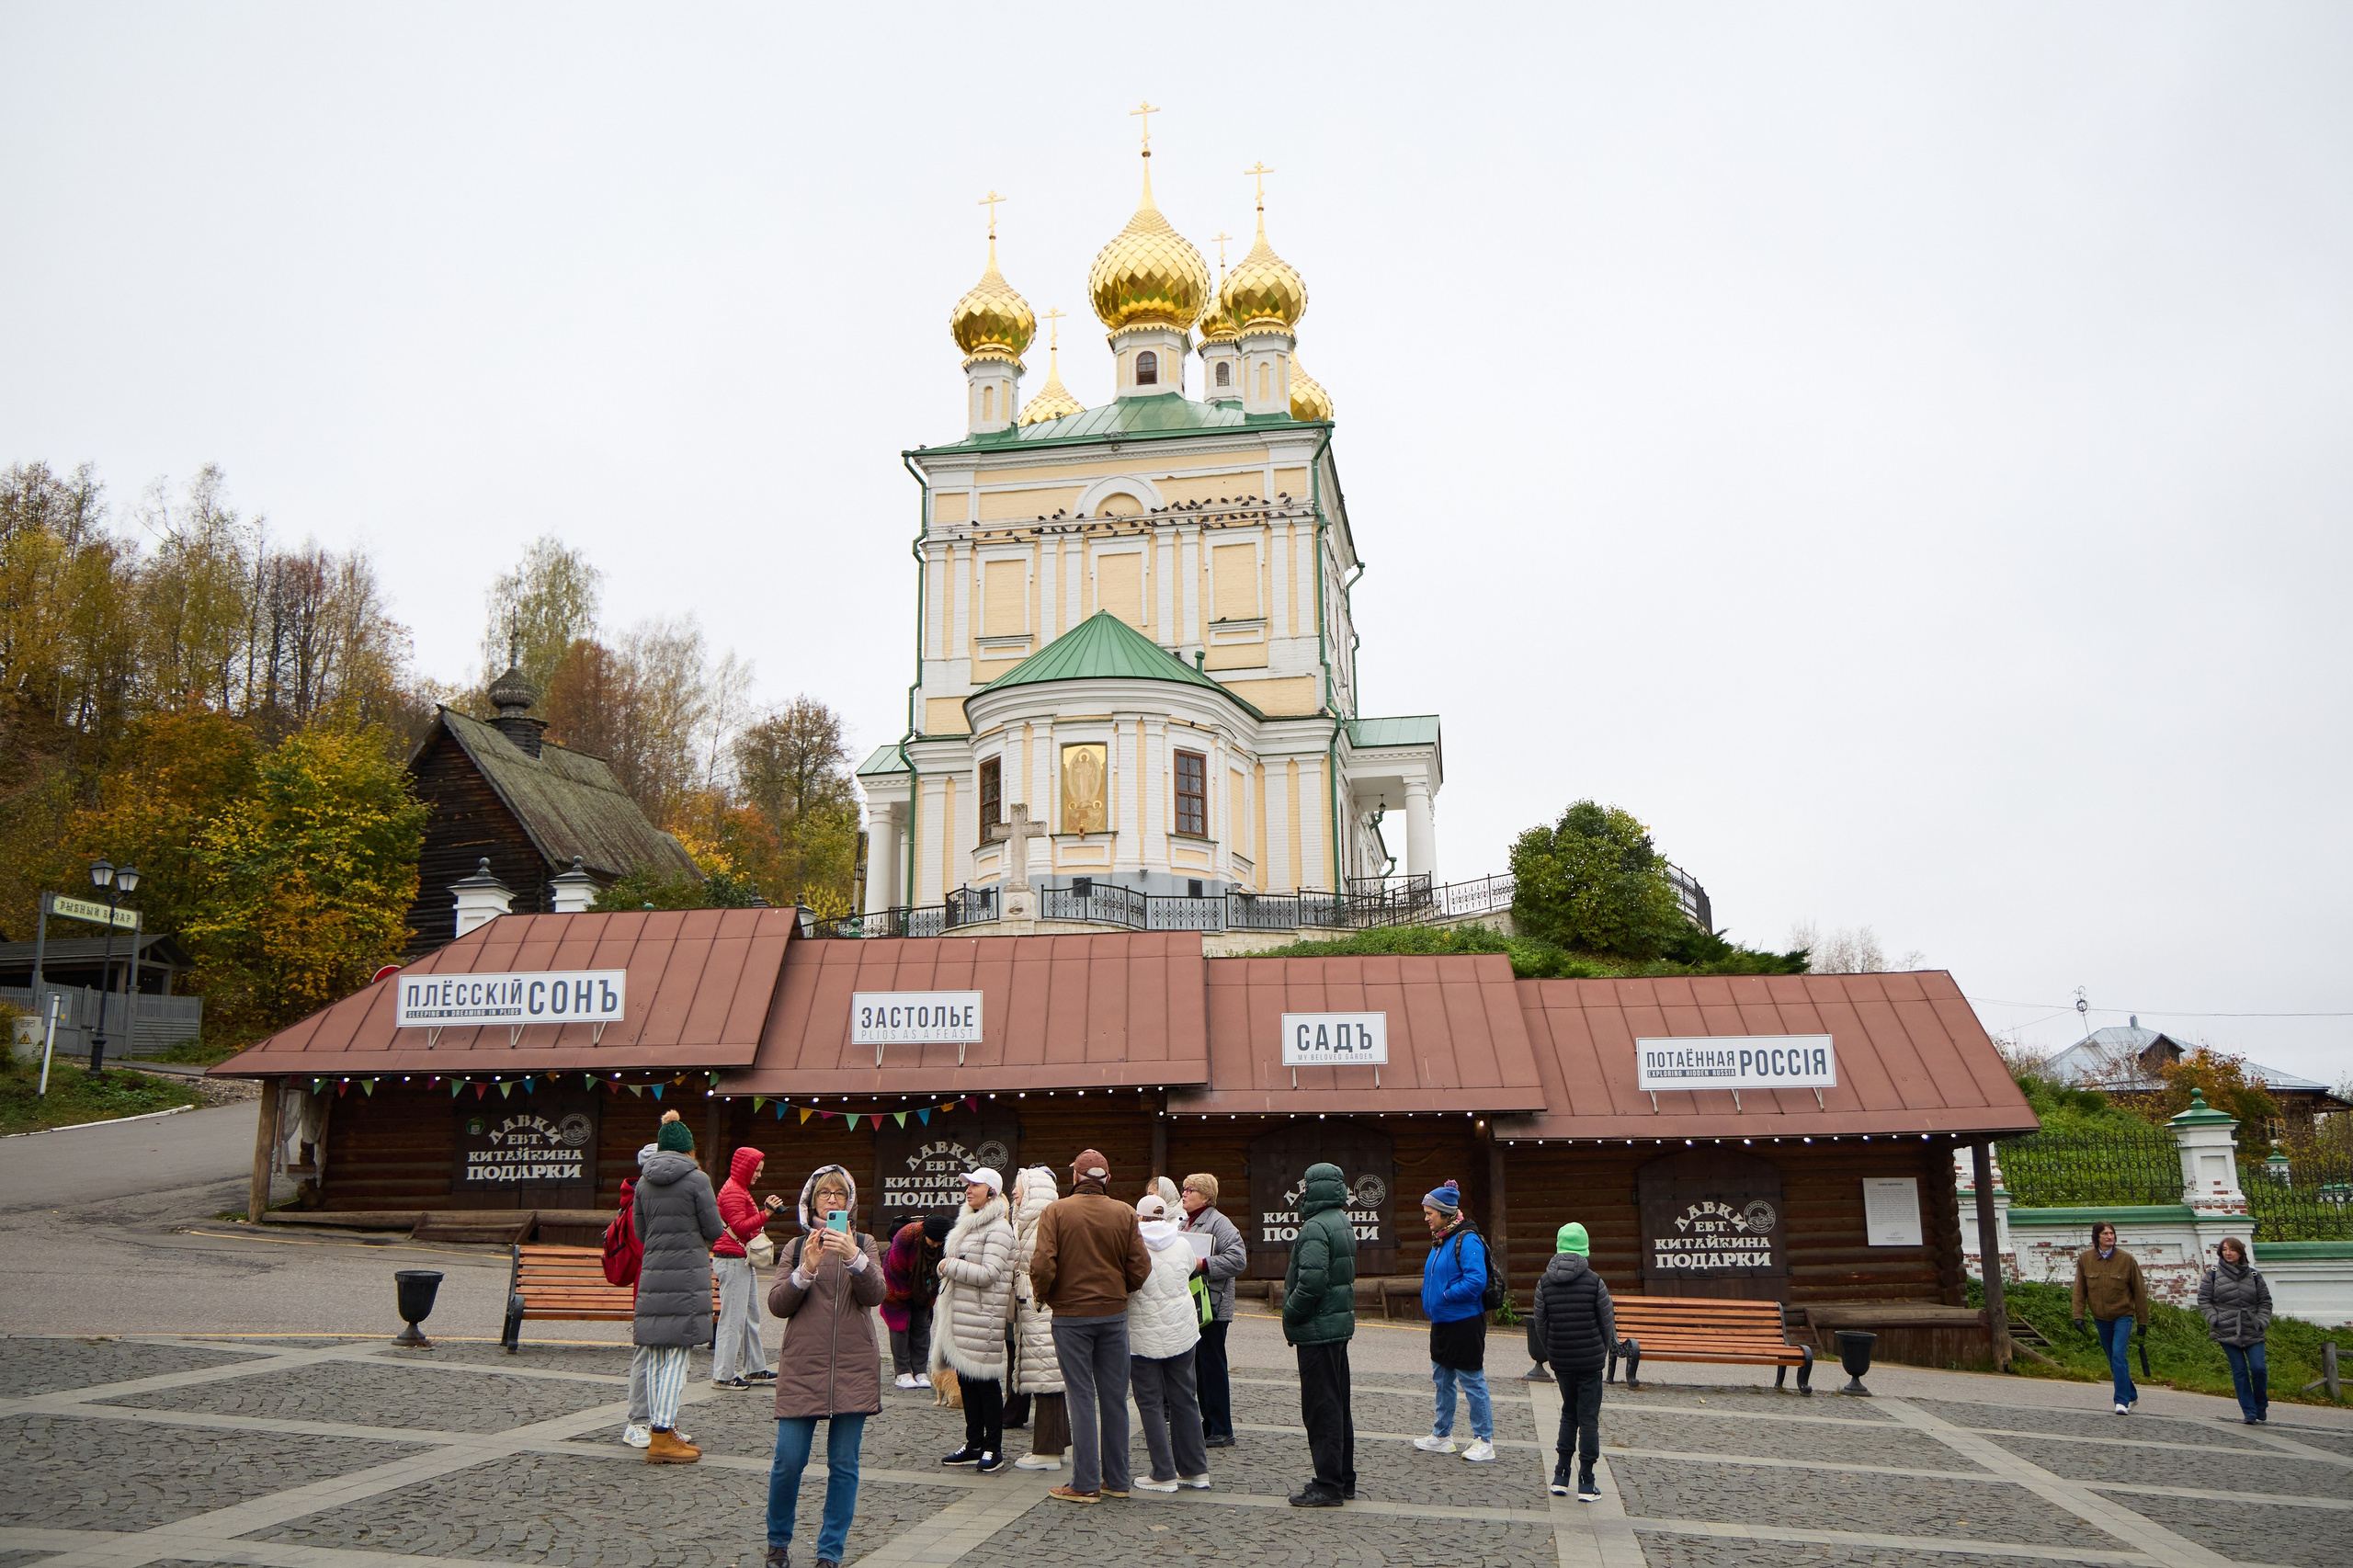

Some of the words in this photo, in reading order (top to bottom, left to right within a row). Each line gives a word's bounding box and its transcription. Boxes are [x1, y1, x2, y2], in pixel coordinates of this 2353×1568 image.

[60, 901, 100, 917] РЫБНЫЙ
[103, 909, 131, 923] БЗАР
[529, 979, 618, 1015] СОНЪ
[407, 1010, 440, 1018] SLEEPING
[861, 1006, 974, 1028] ЗАСТОЛЬЕ
[861, 1029, 896, 1040] PLIOS
[903, 1029, 916, 1040] AS
[924, 1028, 929, 1039] A
[937, 1028, 973, 1039] FEAST
[1297, 1023, 1373, 1053] САДЪ
[1646, 1049, 1735, 1068] ПОТАЁННАЯ
[1739, 1048, 1827, 1076] РОССІЯ
[488, 1115, 563, 1145] ЛАВКИ
[507, 1133, 543, 1144] ЕВТ.
[468, 1147, 584, 1162] КИТАЙКИНА
[905, 1141, 981, 1172] ЛАВКИ
[467, 1165, 582, 1182] ПОДАРКИ
[925, 1160, 961, 1171] ЕВТ.
[884, 1174, 969, 1188] КИТАЙК
[883, 1191, 966, 1209] ПОДАР
[1262, 1210, 1381, 1224] КИТИНА
[1675, 1201, 1748, 1233] ЛАВКИ
[1262, 1226, 1380, 1242] ПОКИ
[1694, 1221, 1730, 1233] ЕВТ.
[1654, 1233, 1771, 1250] КИТАЙКИНА
[1654, 1252, 1771, 1270] ПОДАРКИ
